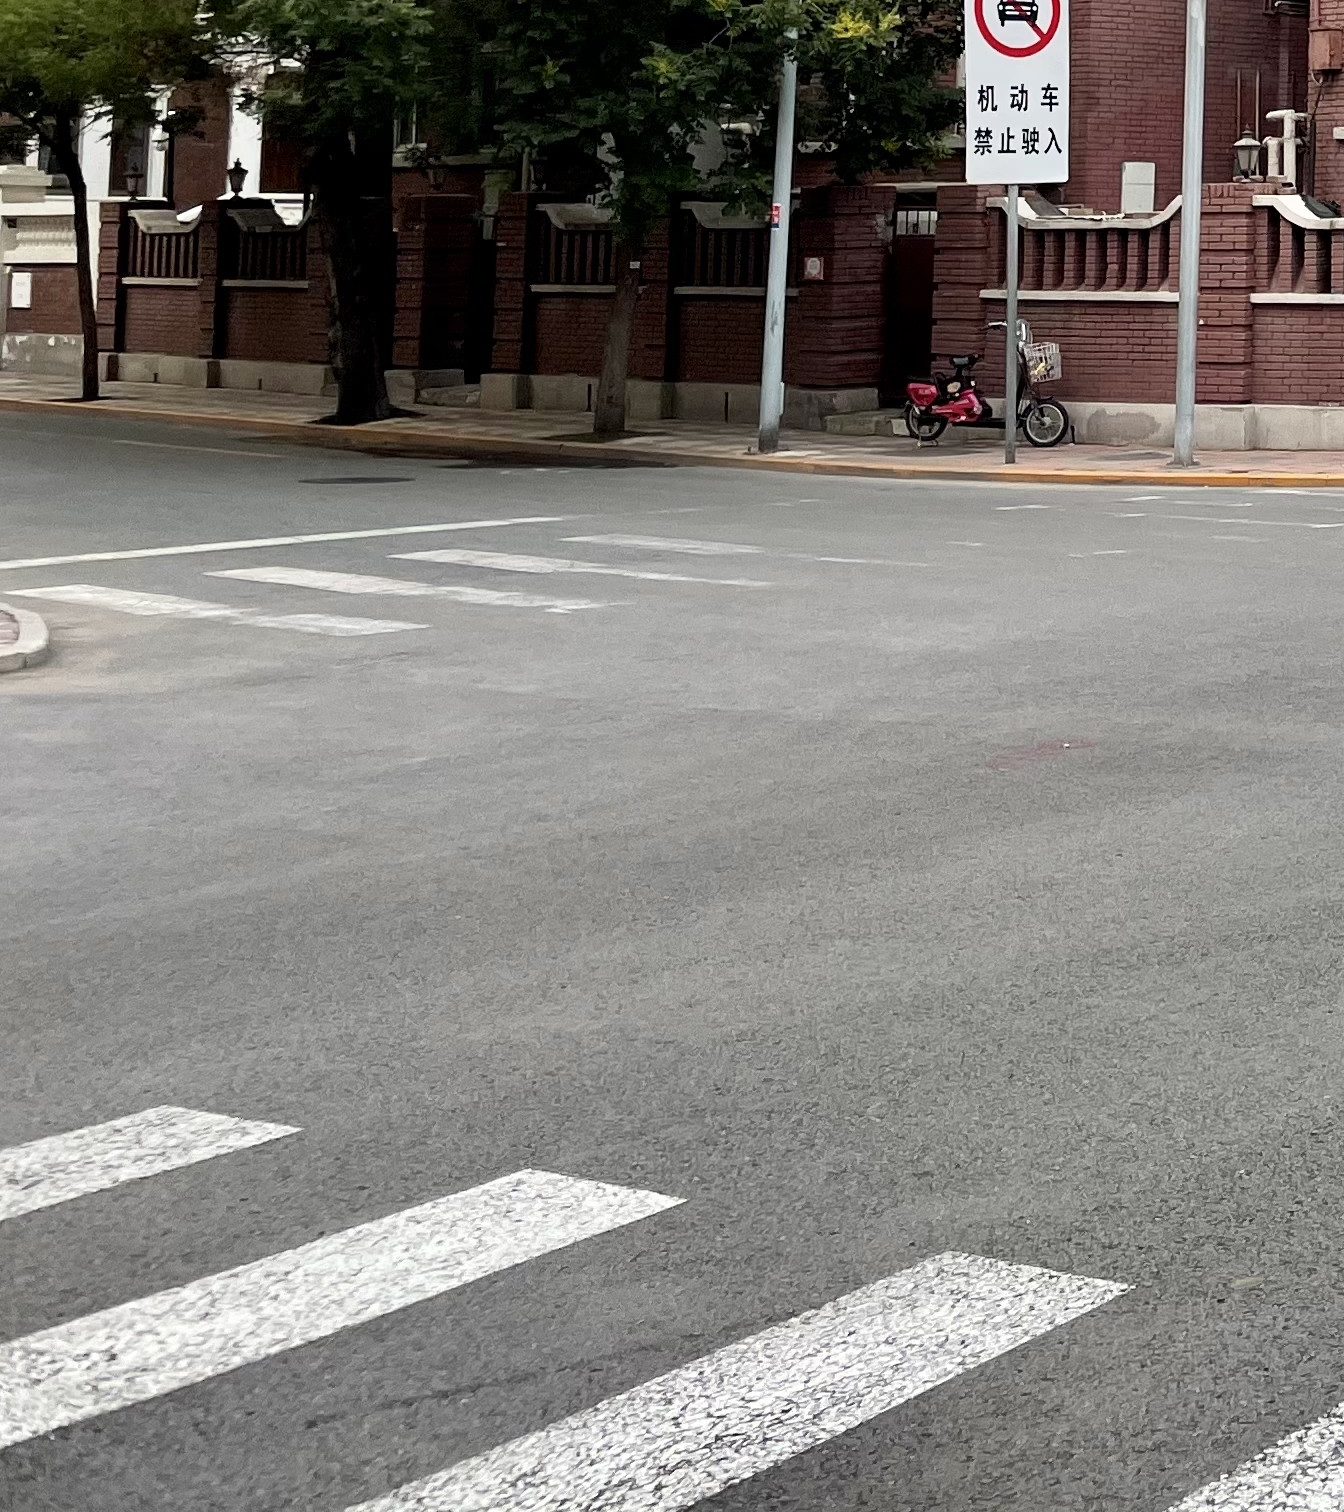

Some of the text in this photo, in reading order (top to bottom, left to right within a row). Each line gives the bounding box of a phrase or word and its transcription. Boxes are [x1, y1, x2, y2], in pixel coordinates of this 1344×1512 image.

[977, 83, 1059, 112] 机动车
[973, 127, 1062, 155] 禁止驶入
